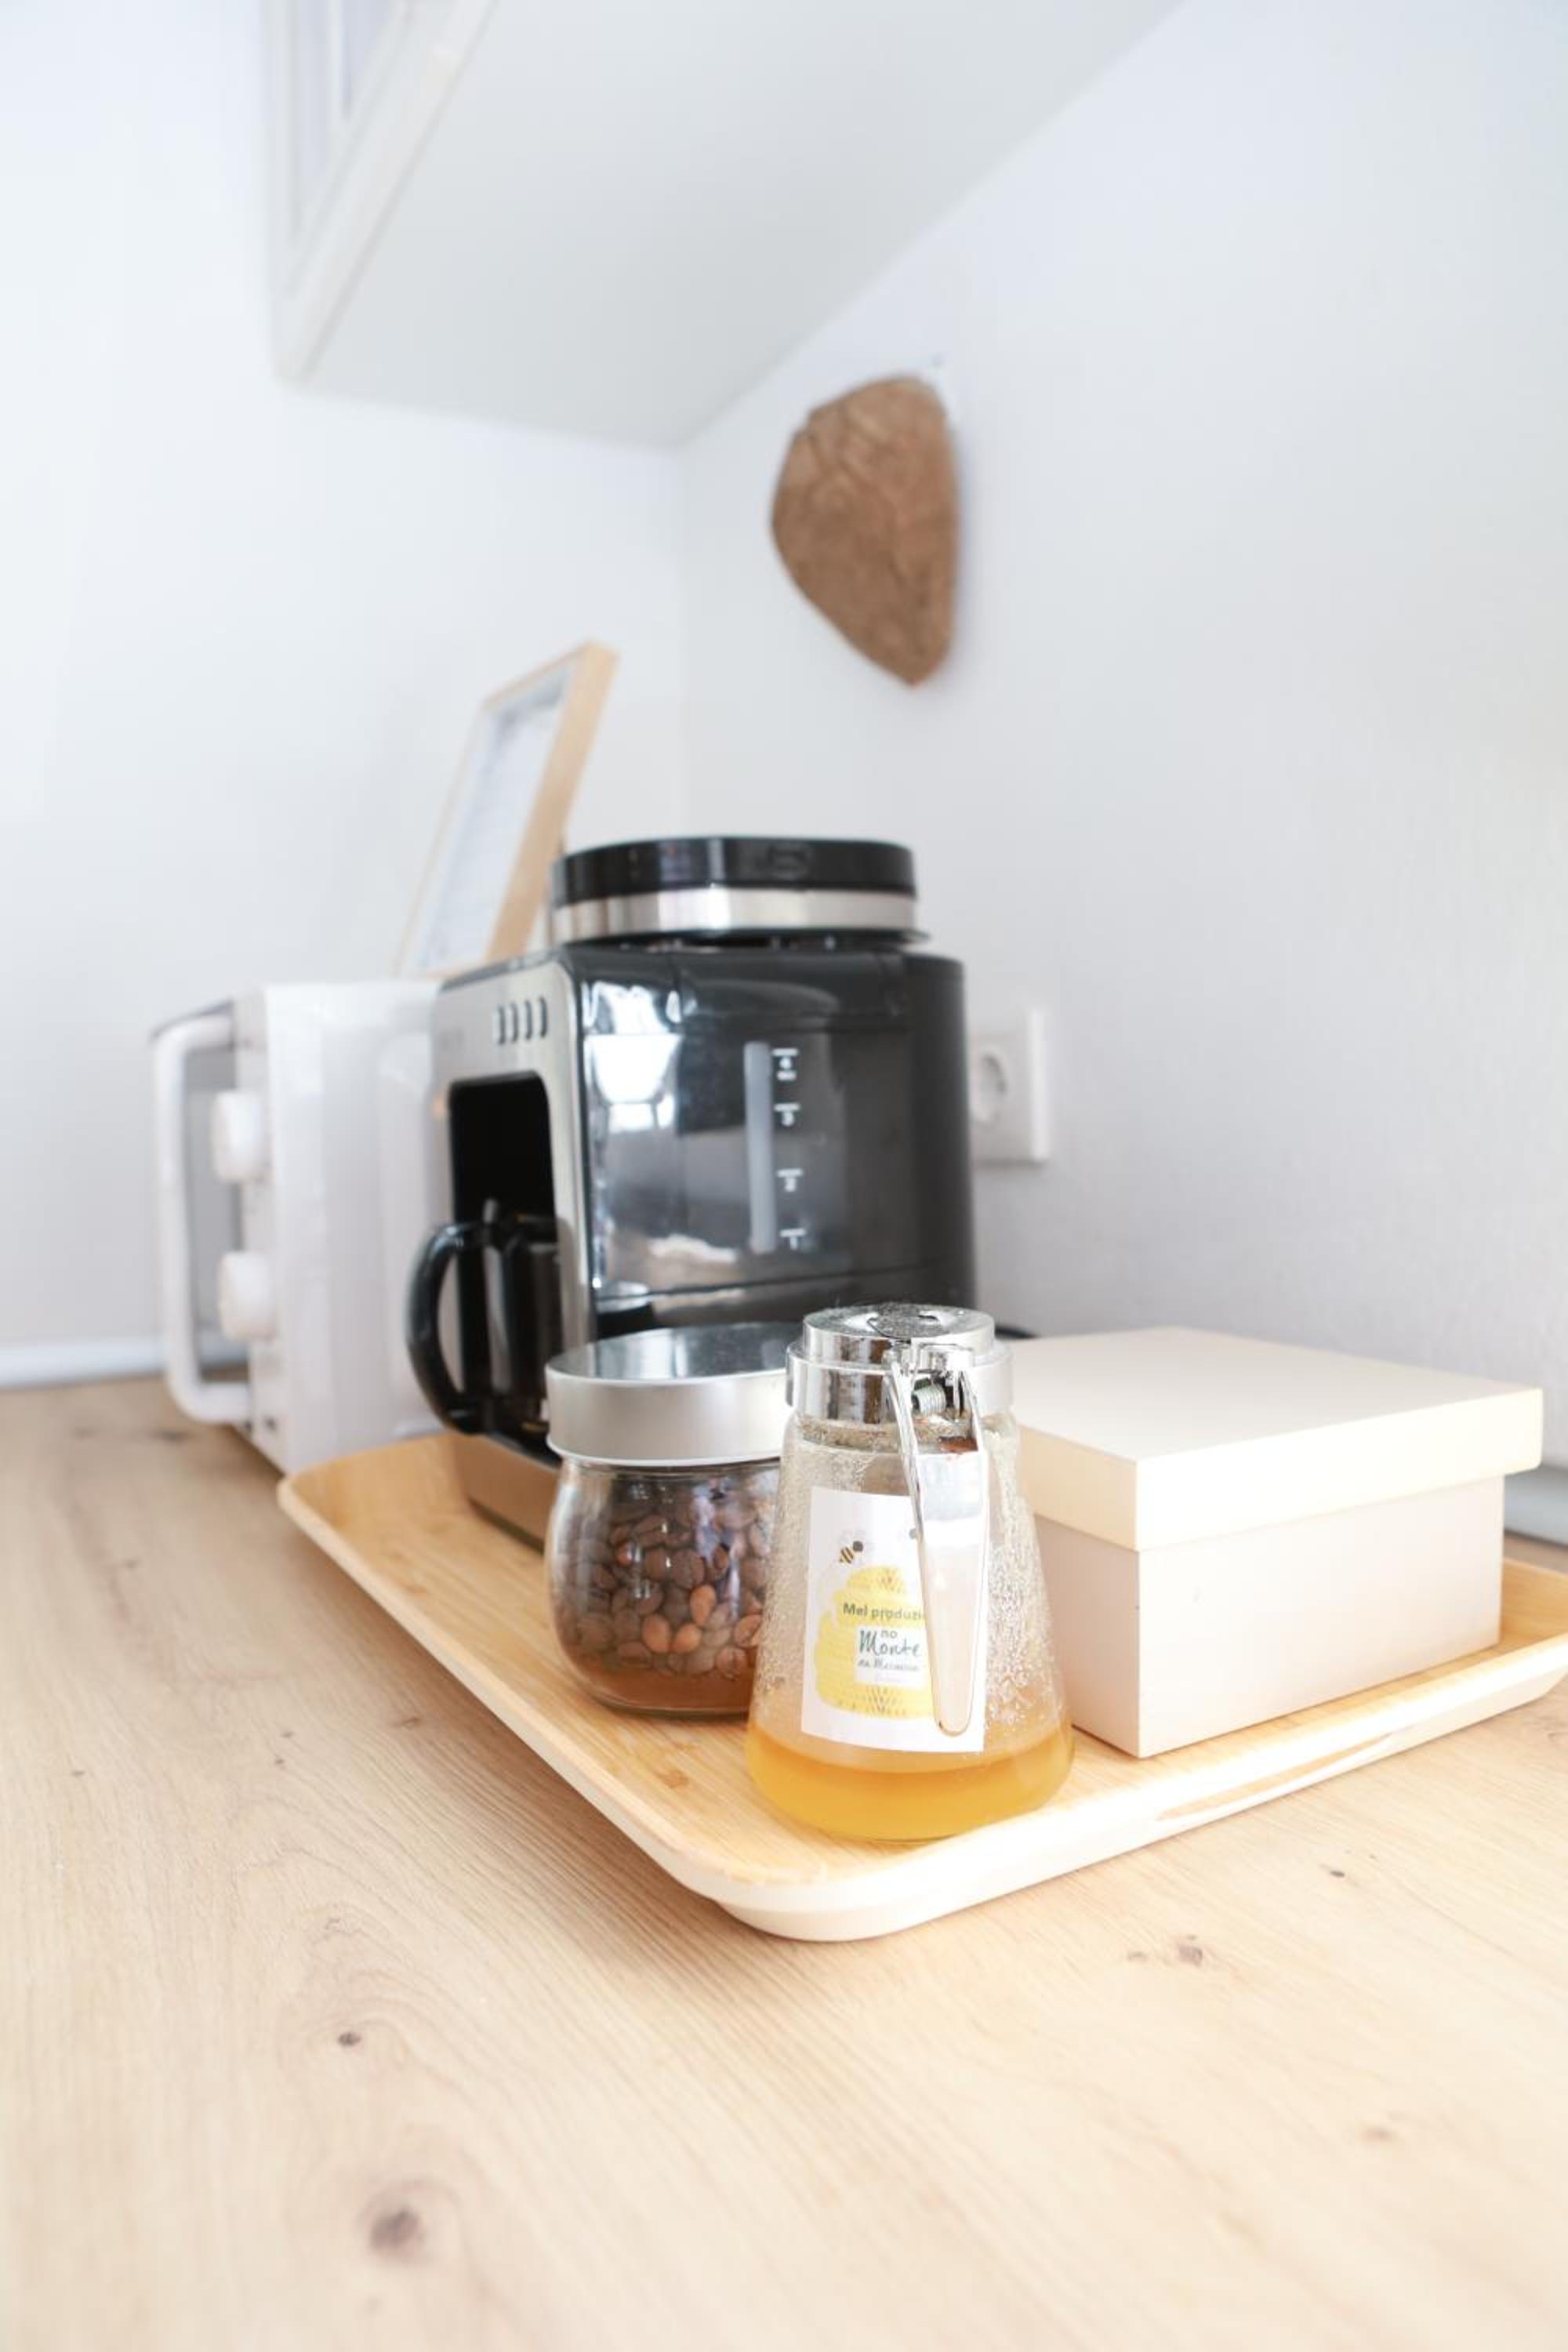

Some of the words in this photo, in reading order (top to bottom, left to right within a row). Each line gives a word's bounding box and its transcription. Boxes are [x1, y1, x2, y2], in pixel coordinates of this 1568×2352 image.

[843, 1602, 867, 1617] Mel
[871, 1608, 922, 1621] produzi
[859, 1629, 920, 1656] Monte
[880, 1630, 898, 1639] no
